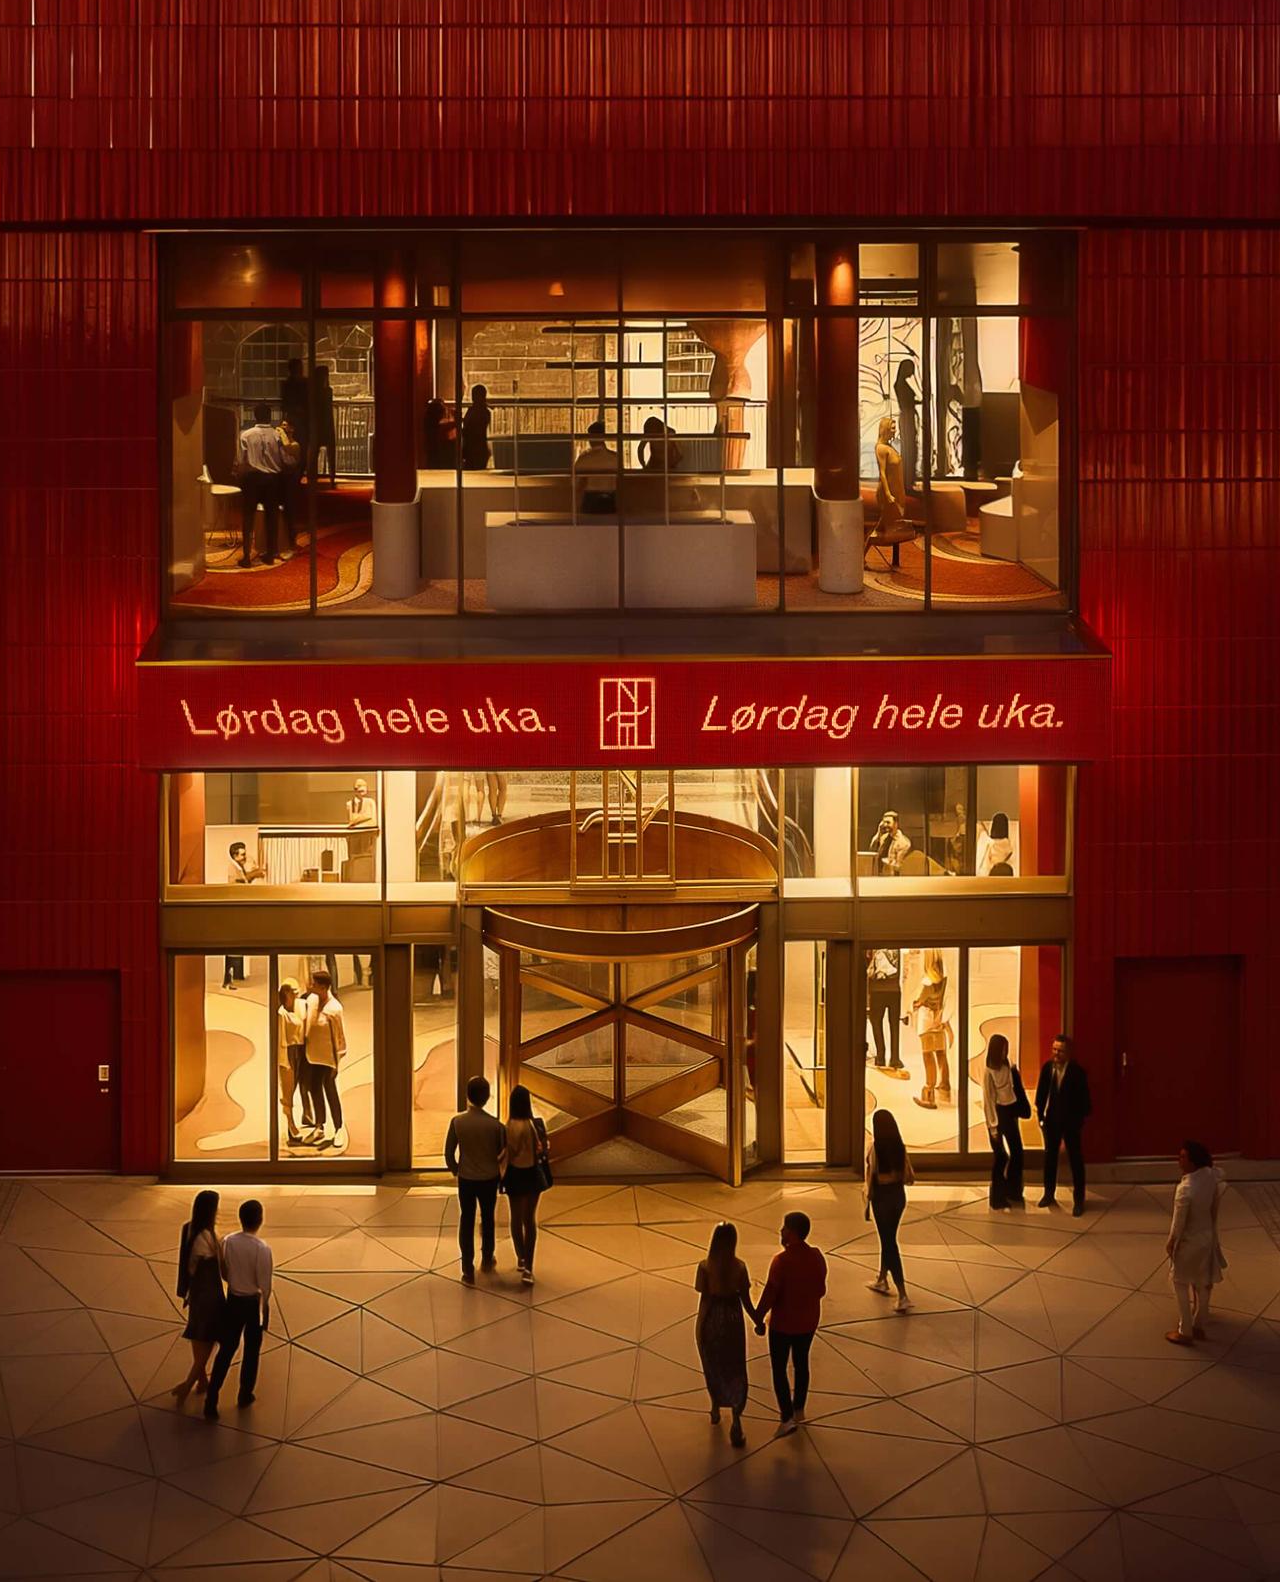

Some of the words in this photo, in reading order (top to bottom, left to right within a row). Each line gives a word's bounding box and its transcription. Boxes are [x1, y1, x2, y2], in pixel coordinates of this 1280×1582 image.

[180, 698, 346, 744] Lørdag
[353, 698, 450, 734] hele
[461, 697, 557, 734] uka.
[700, 695, 860, 740] Lørdag
[872, 693, 963, 730] hele
[977, 693, 1064, 729] uka.
